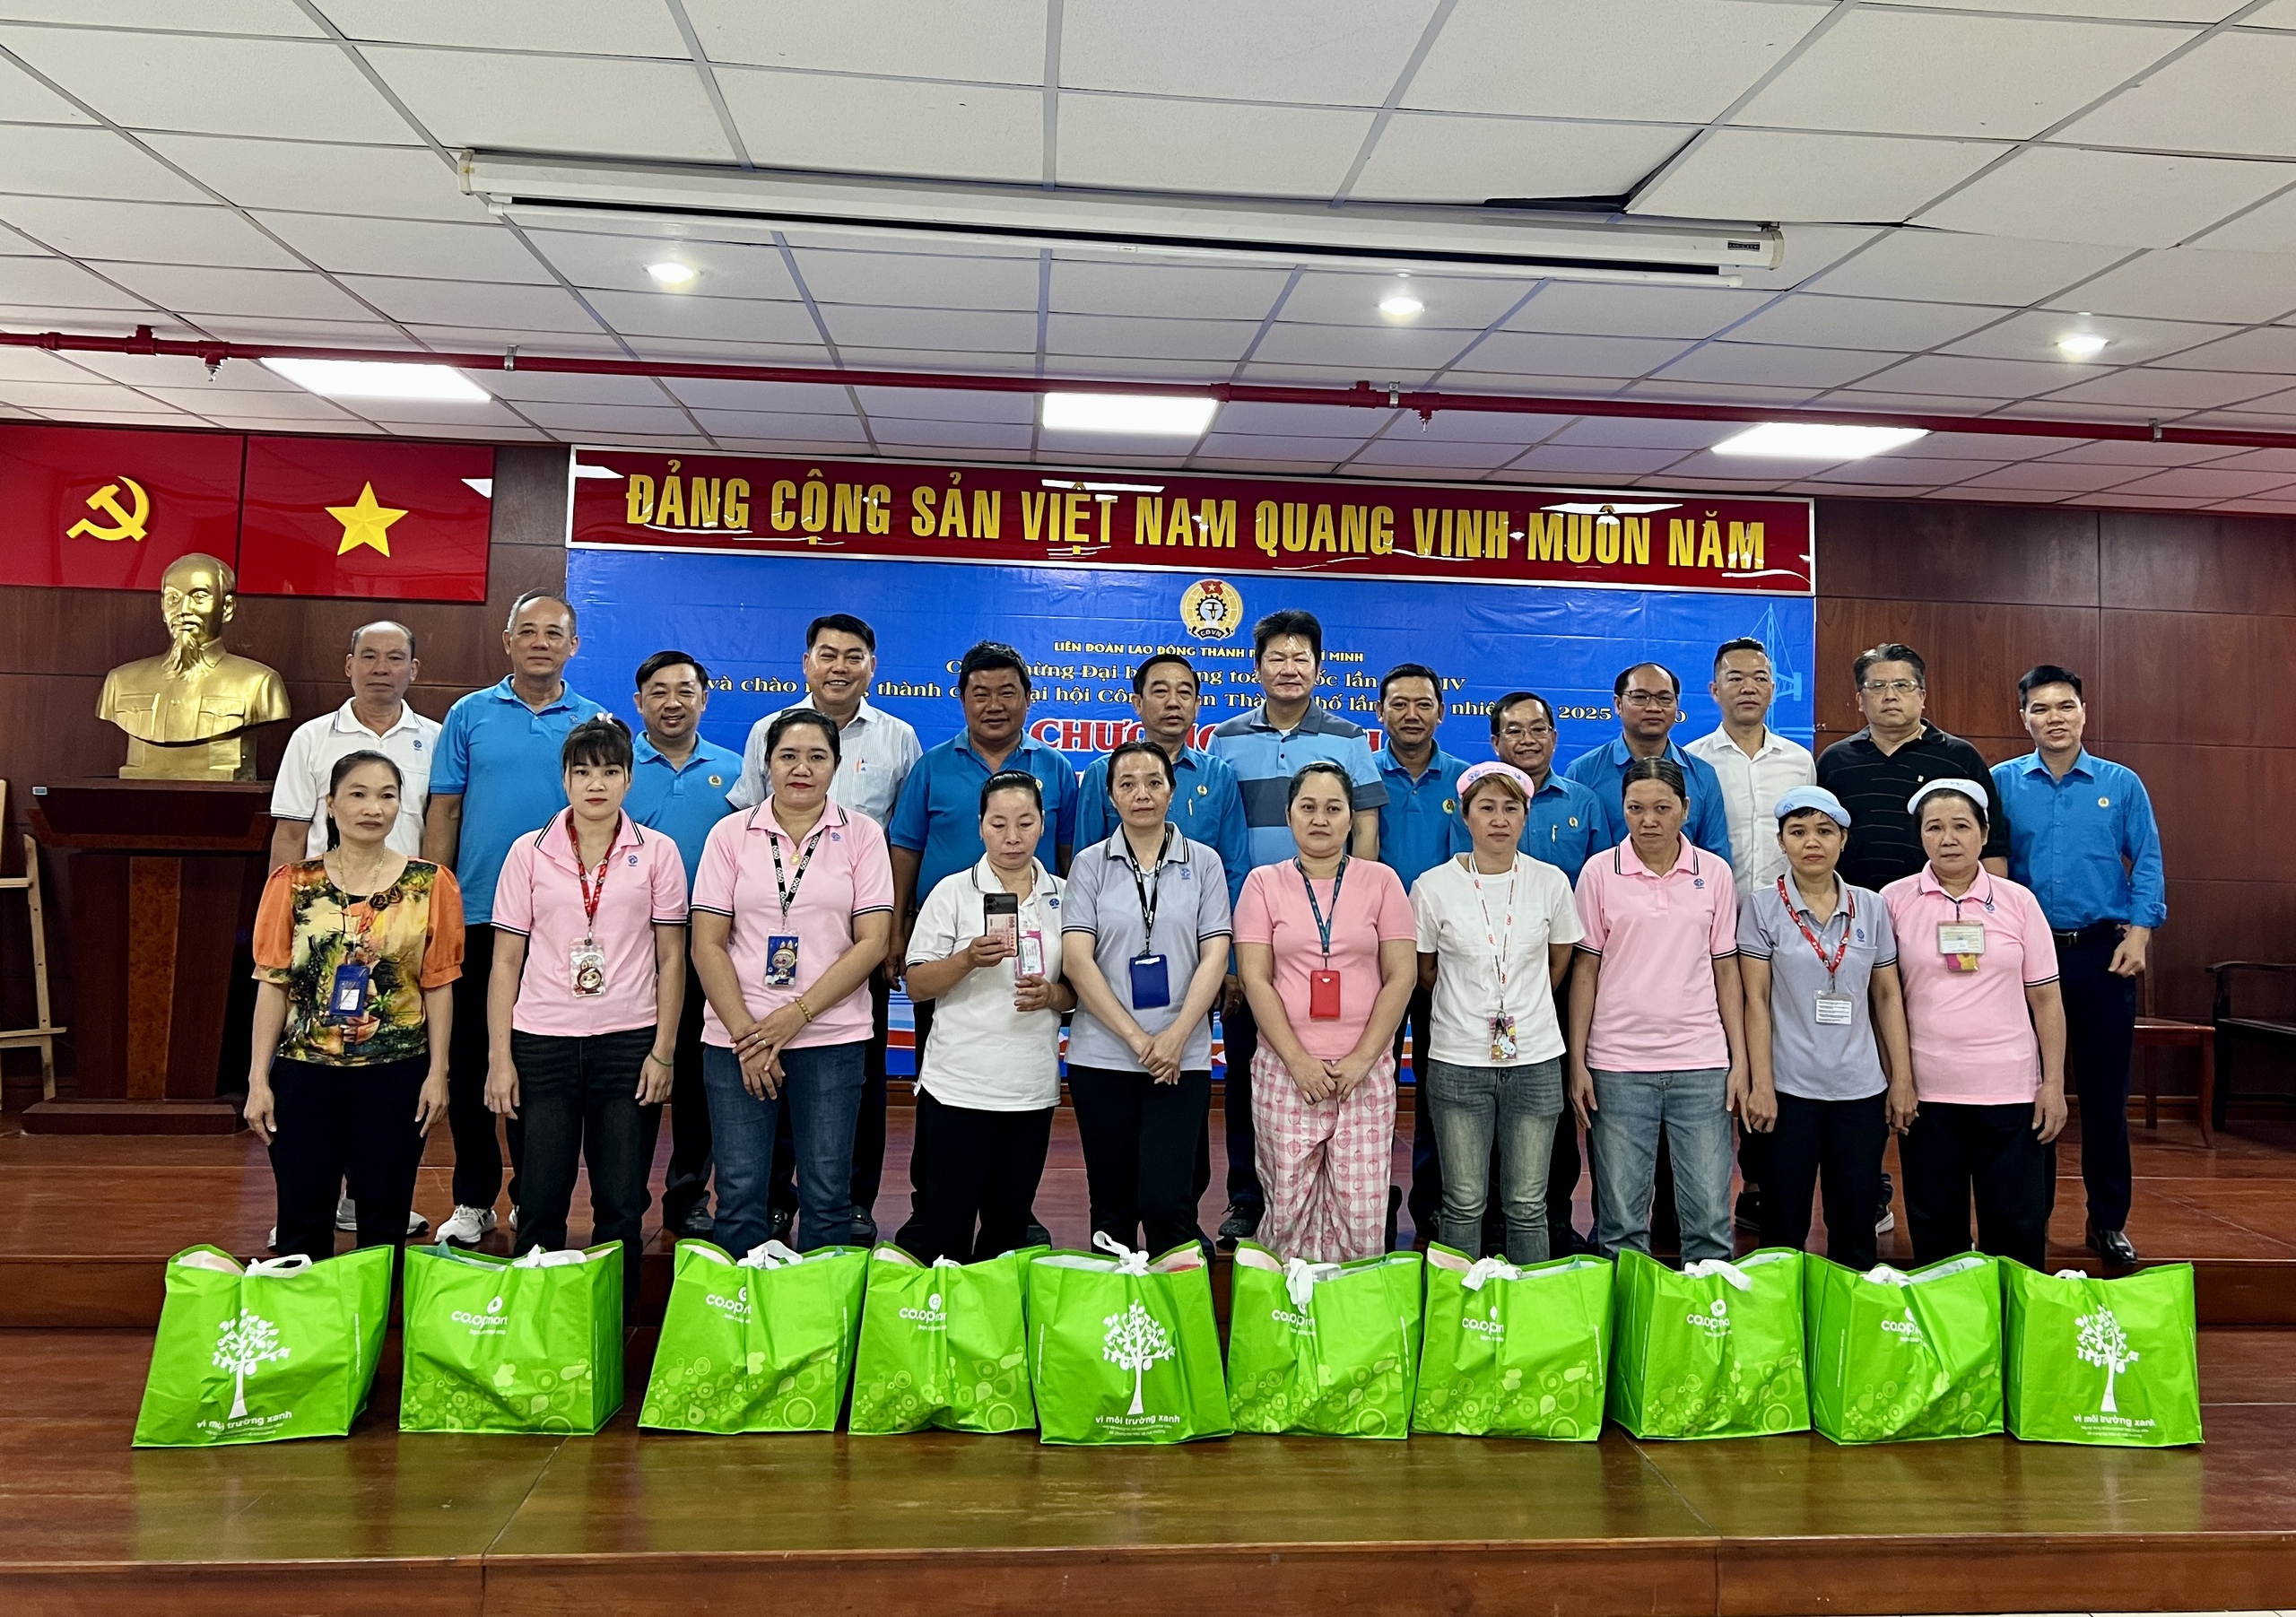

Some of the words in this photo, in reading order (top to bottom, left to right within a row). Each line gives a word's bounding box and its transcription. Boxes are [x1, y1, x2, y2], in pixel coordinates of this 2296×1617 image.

[626, 459, 750, 529] ĐẢNG
[771, 469, 891, 545] CỘNG
[911, 472, 1000, 539] SẢN
[1021, 481, 1118, 554] VIỆT
[1135, 496, 1237, 548] NAM
[1256, 500, 1395, 558] QUANG
[1413, 508, 1509, 560] VINH
[1526, 504, 1651, 567] MUÔN
[1667, 508, 1765, 569] NĂM
[1054, 640, 1082, 653] LIÊN
[1085, 641, 1124, 654] ĐOÀN
[1128, 645, 1153, 655] LAO
[1200, 646, 1245, 658] THÀNH
[1329, 652, 1364, 663] MINH
[1081, 664, 1118, 679] Đại
[1230, 668, 1260, 684] toà
[1344, 670, 1378, 688] lần
[1440, 678, 1465, 691] IV
[708, 676, 733, 691] và
[741, 677, 798, 692] chào
[877, 681, 942, 697] thành
[1030, 687, 1048, 704] ại
[1056, 686, 1091, 704] hội
[1223, 694, 1265, 709] Thà
[1558, 706, 1612, 721] 2025
[267, 1411, 292, 1423] xanh
[1106, 1416, 1123, 1424] môi
[1126, 1415, 1156, 1425] trường
[1159, 1414, 1180, 1423] xanh
[2100, 1414, 2132, 1427] trường
[2135, 1419, 2155, 1427] xanh
